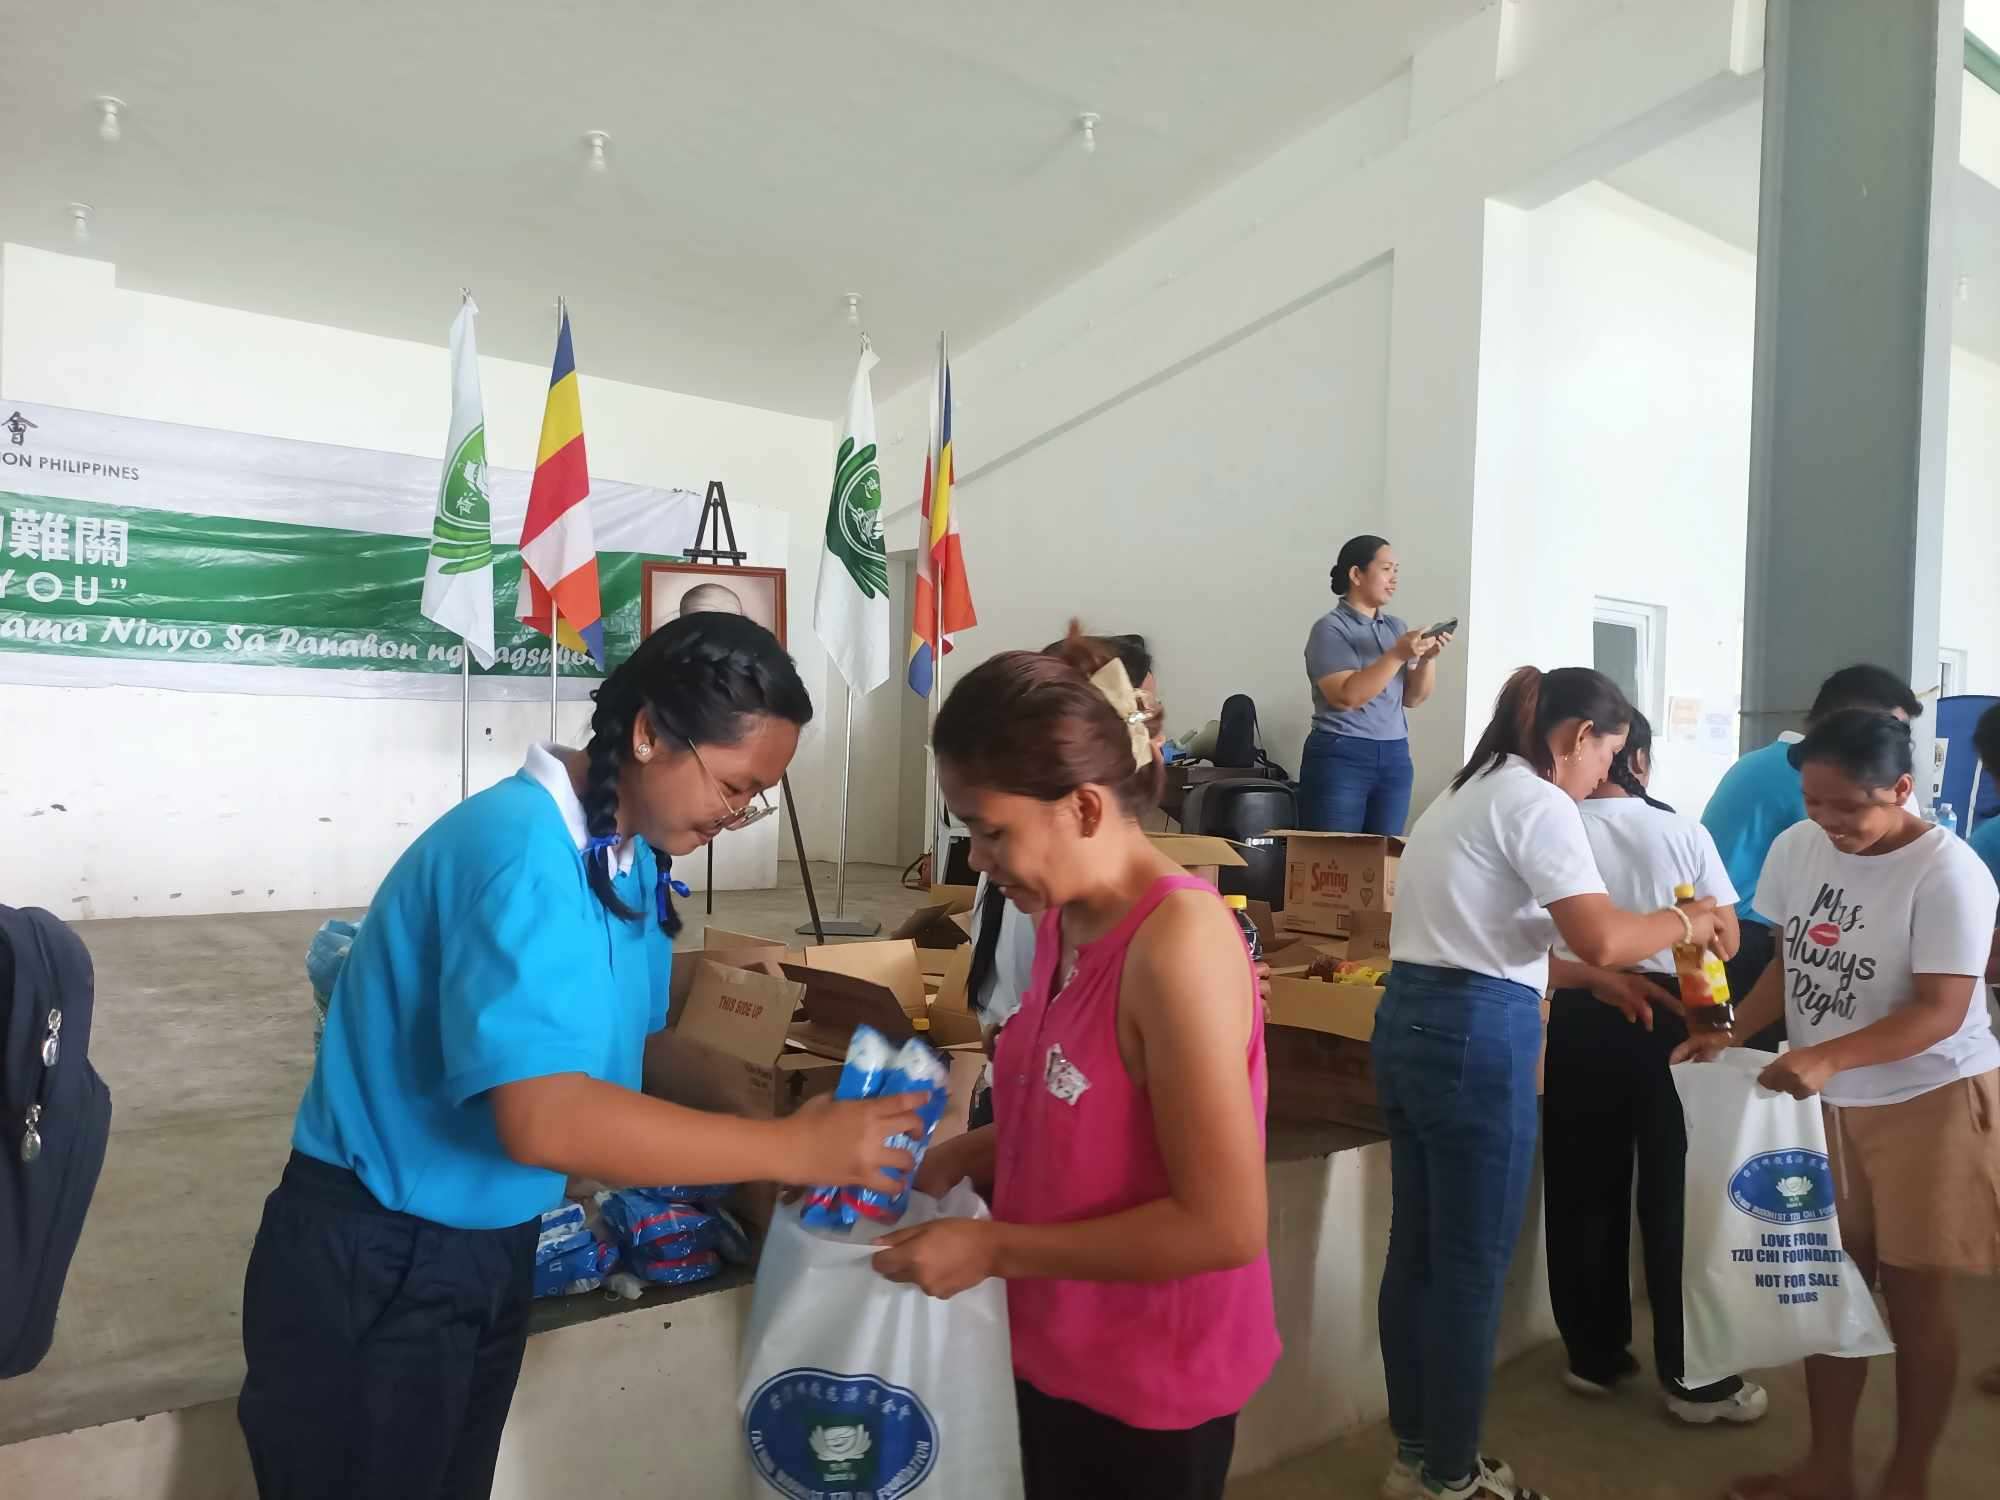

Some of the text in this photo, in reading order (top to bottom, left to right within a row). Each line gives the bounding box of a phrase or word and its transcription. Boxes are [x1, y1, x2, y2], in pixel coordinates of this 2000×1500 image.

[0, 452, 140, 481] ON PHILIPPINES
[0, 508, 128, 568] 難關
[100, 617, 212, 652] Ninyo
[223, 625, 265, 651] Sa
[278, 627, 417, 660] Panahon
[427, 643, 465, 668] ng
[1311, 862, 1349, 893] Spring
[1809, 883, 1865, 932] Mrs.
[1785, 915, 1877, 991] Always
[719, 995, 764, 1020] THIS SIDE UP
[1785, 968, 1857, 1026] Right
[1761, 1233, 1828, 1248] LOVE FROM
[1731, 1248, 1843, 1264] TZU CHI FOUNDATI
[1755, 1272, 1841, 1288] NOT FOR SALE
[1778, 1294, 1790, 1304] 10
